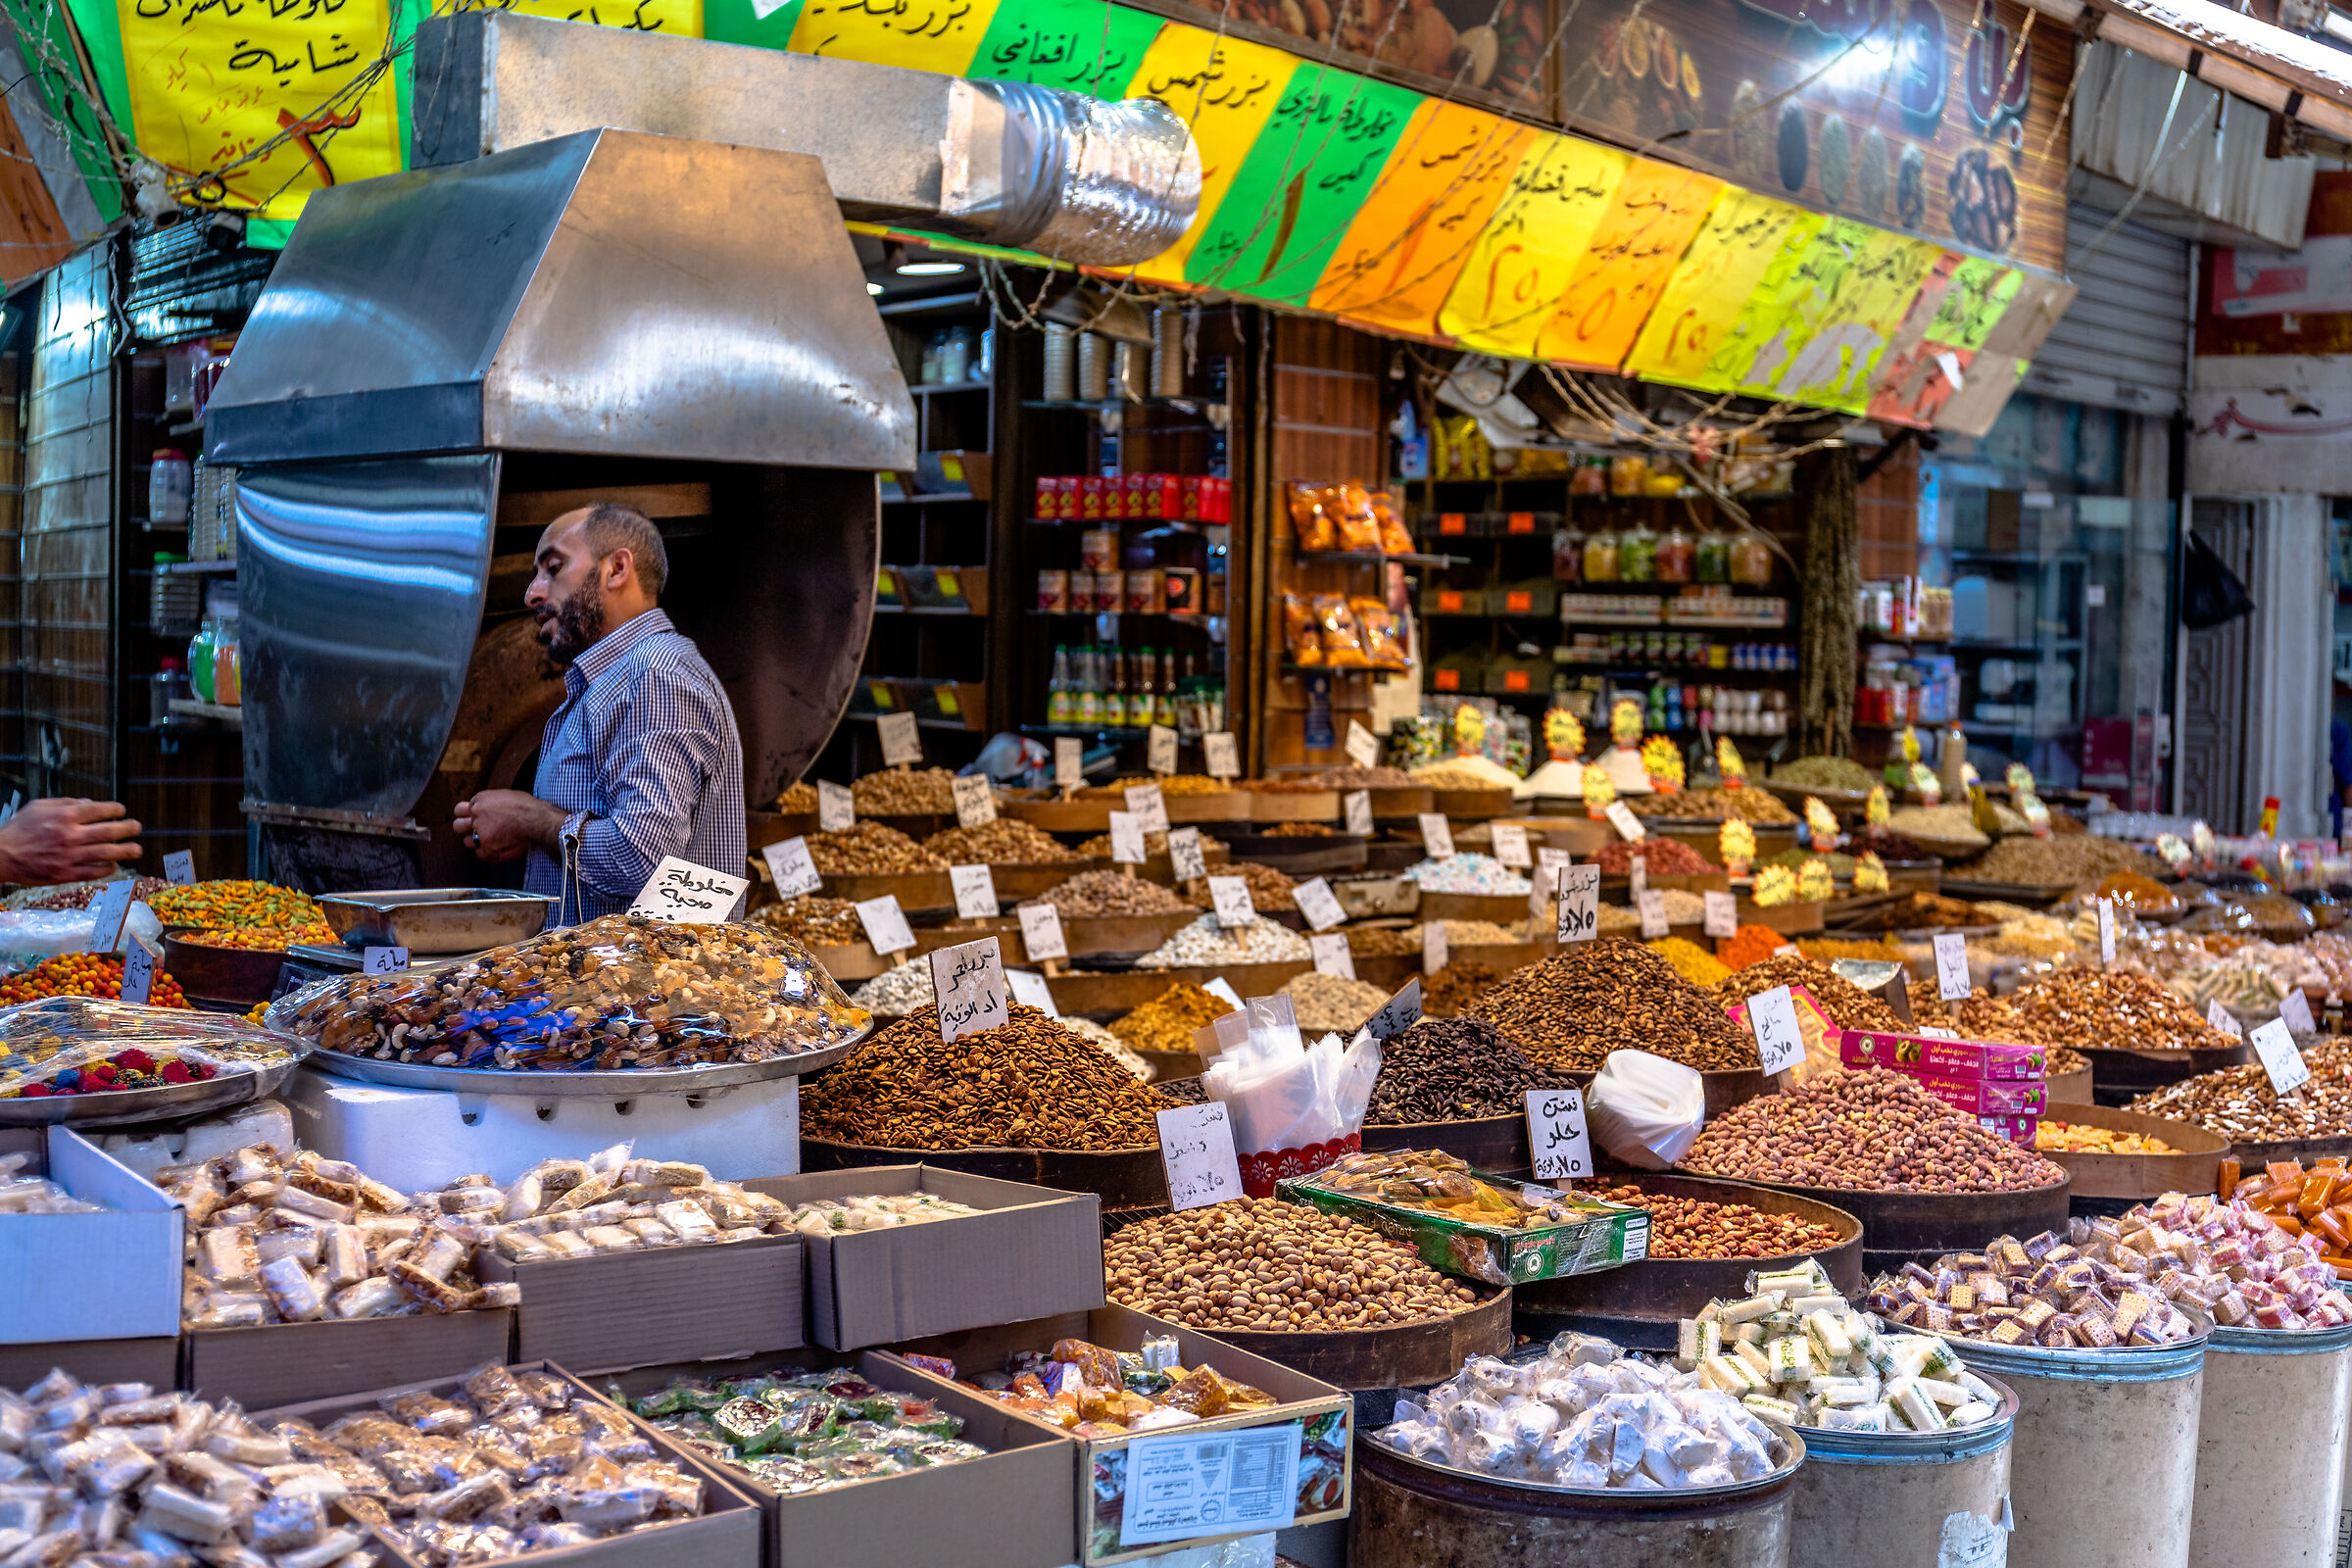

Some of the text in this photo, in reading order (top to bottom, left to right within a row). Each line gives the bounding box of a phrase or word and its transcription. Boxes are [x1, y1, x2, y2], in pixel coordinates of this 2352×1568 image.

[992, 23, 1126, 84] بزر افغاني
[1148, 50, 1271, 109] بزر شمس
[967, 947, 996, 972] بزر
[1381, 1220, 1412, 1239] DRIED
